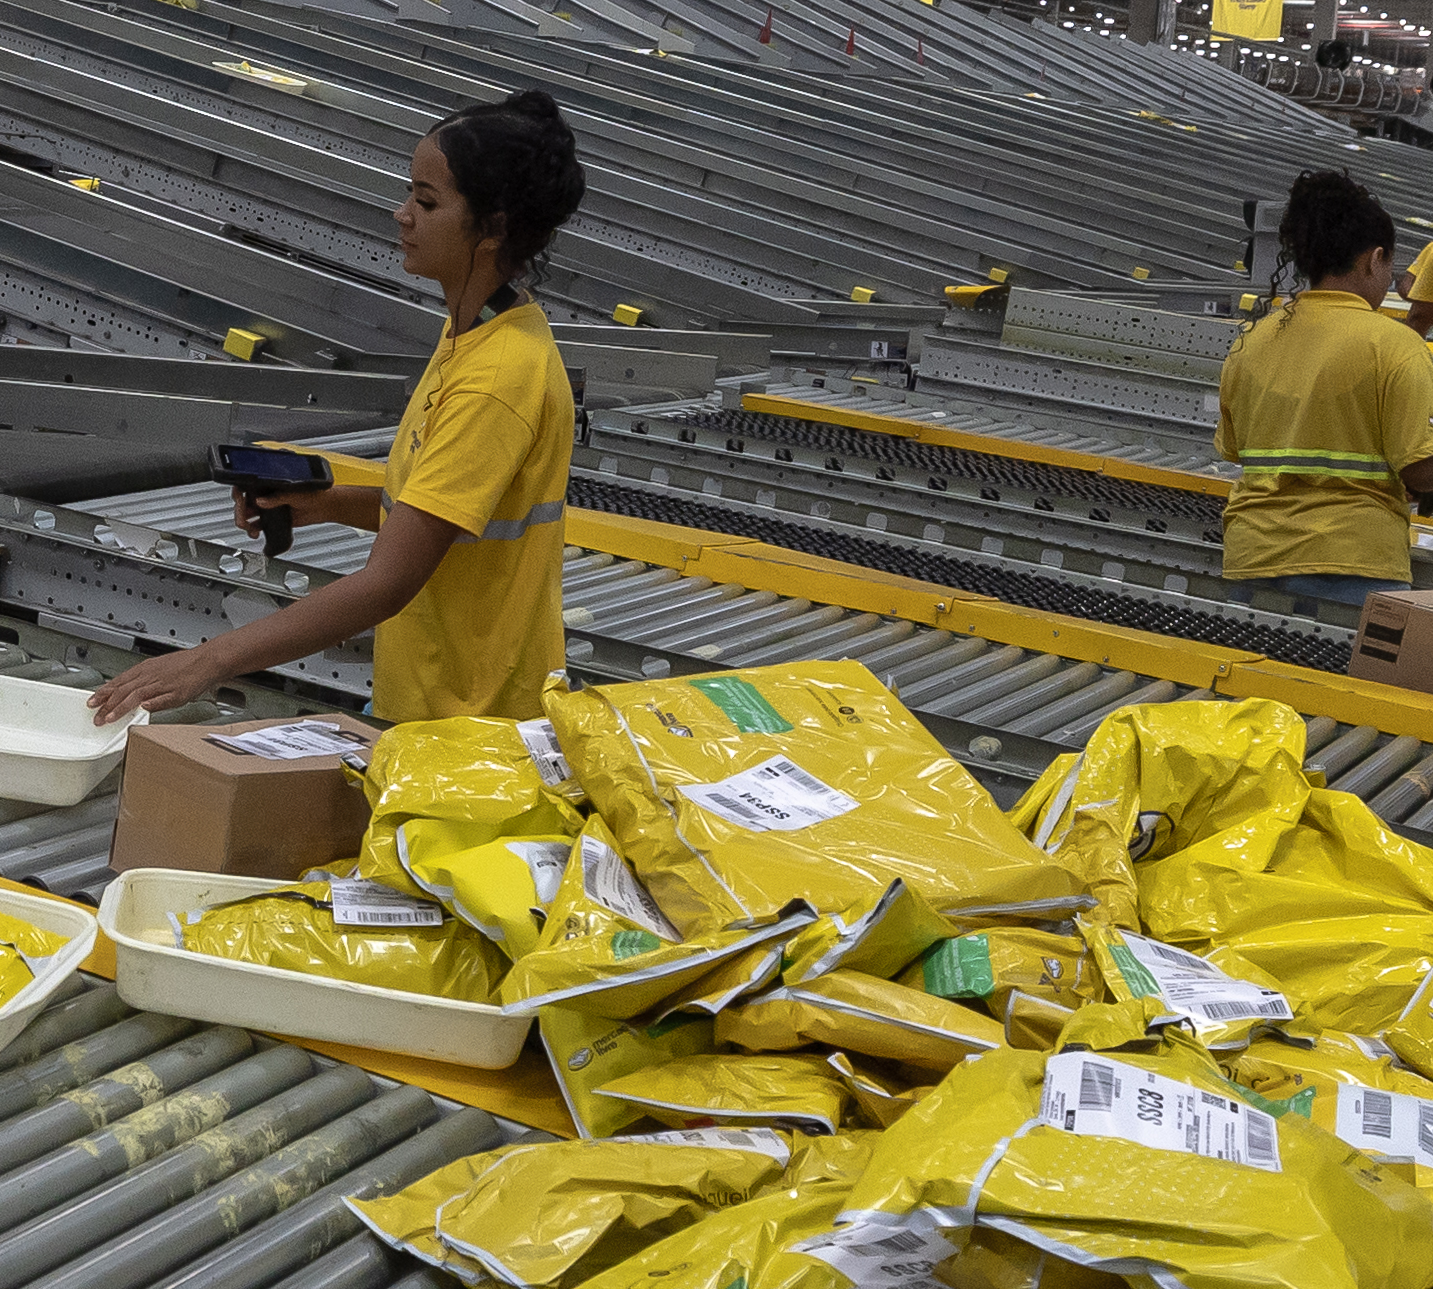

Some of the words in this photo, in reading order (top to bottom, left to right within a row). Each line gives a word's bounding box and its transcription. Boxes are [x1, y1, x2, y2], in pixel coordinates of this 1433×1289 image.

[738, 791, 791, 821] SSP34
[1137, 1087, 1164, 1127] SSC8
[880, 1260, 934, 1278] SSC
